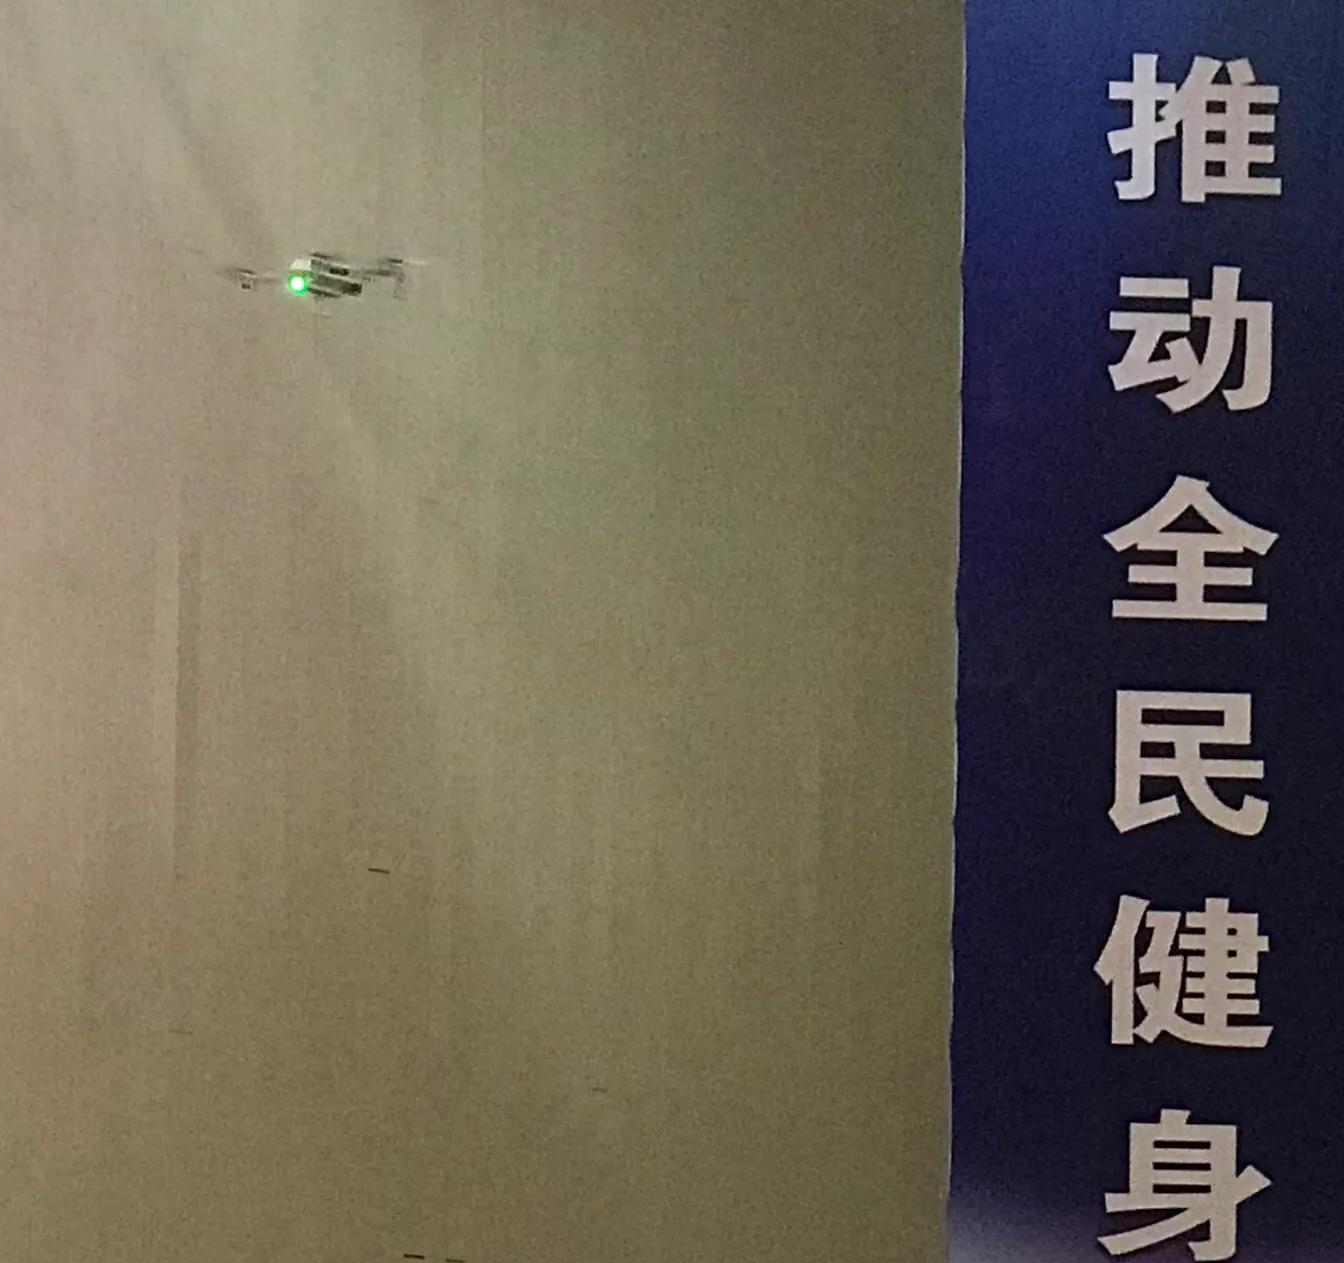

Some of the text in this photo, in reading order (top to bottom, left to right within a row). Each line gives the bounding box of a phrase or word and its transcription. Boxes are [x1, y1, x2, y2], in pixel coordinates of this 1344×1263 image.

[1094, 53, 1282, 1263] 推动全民健身
